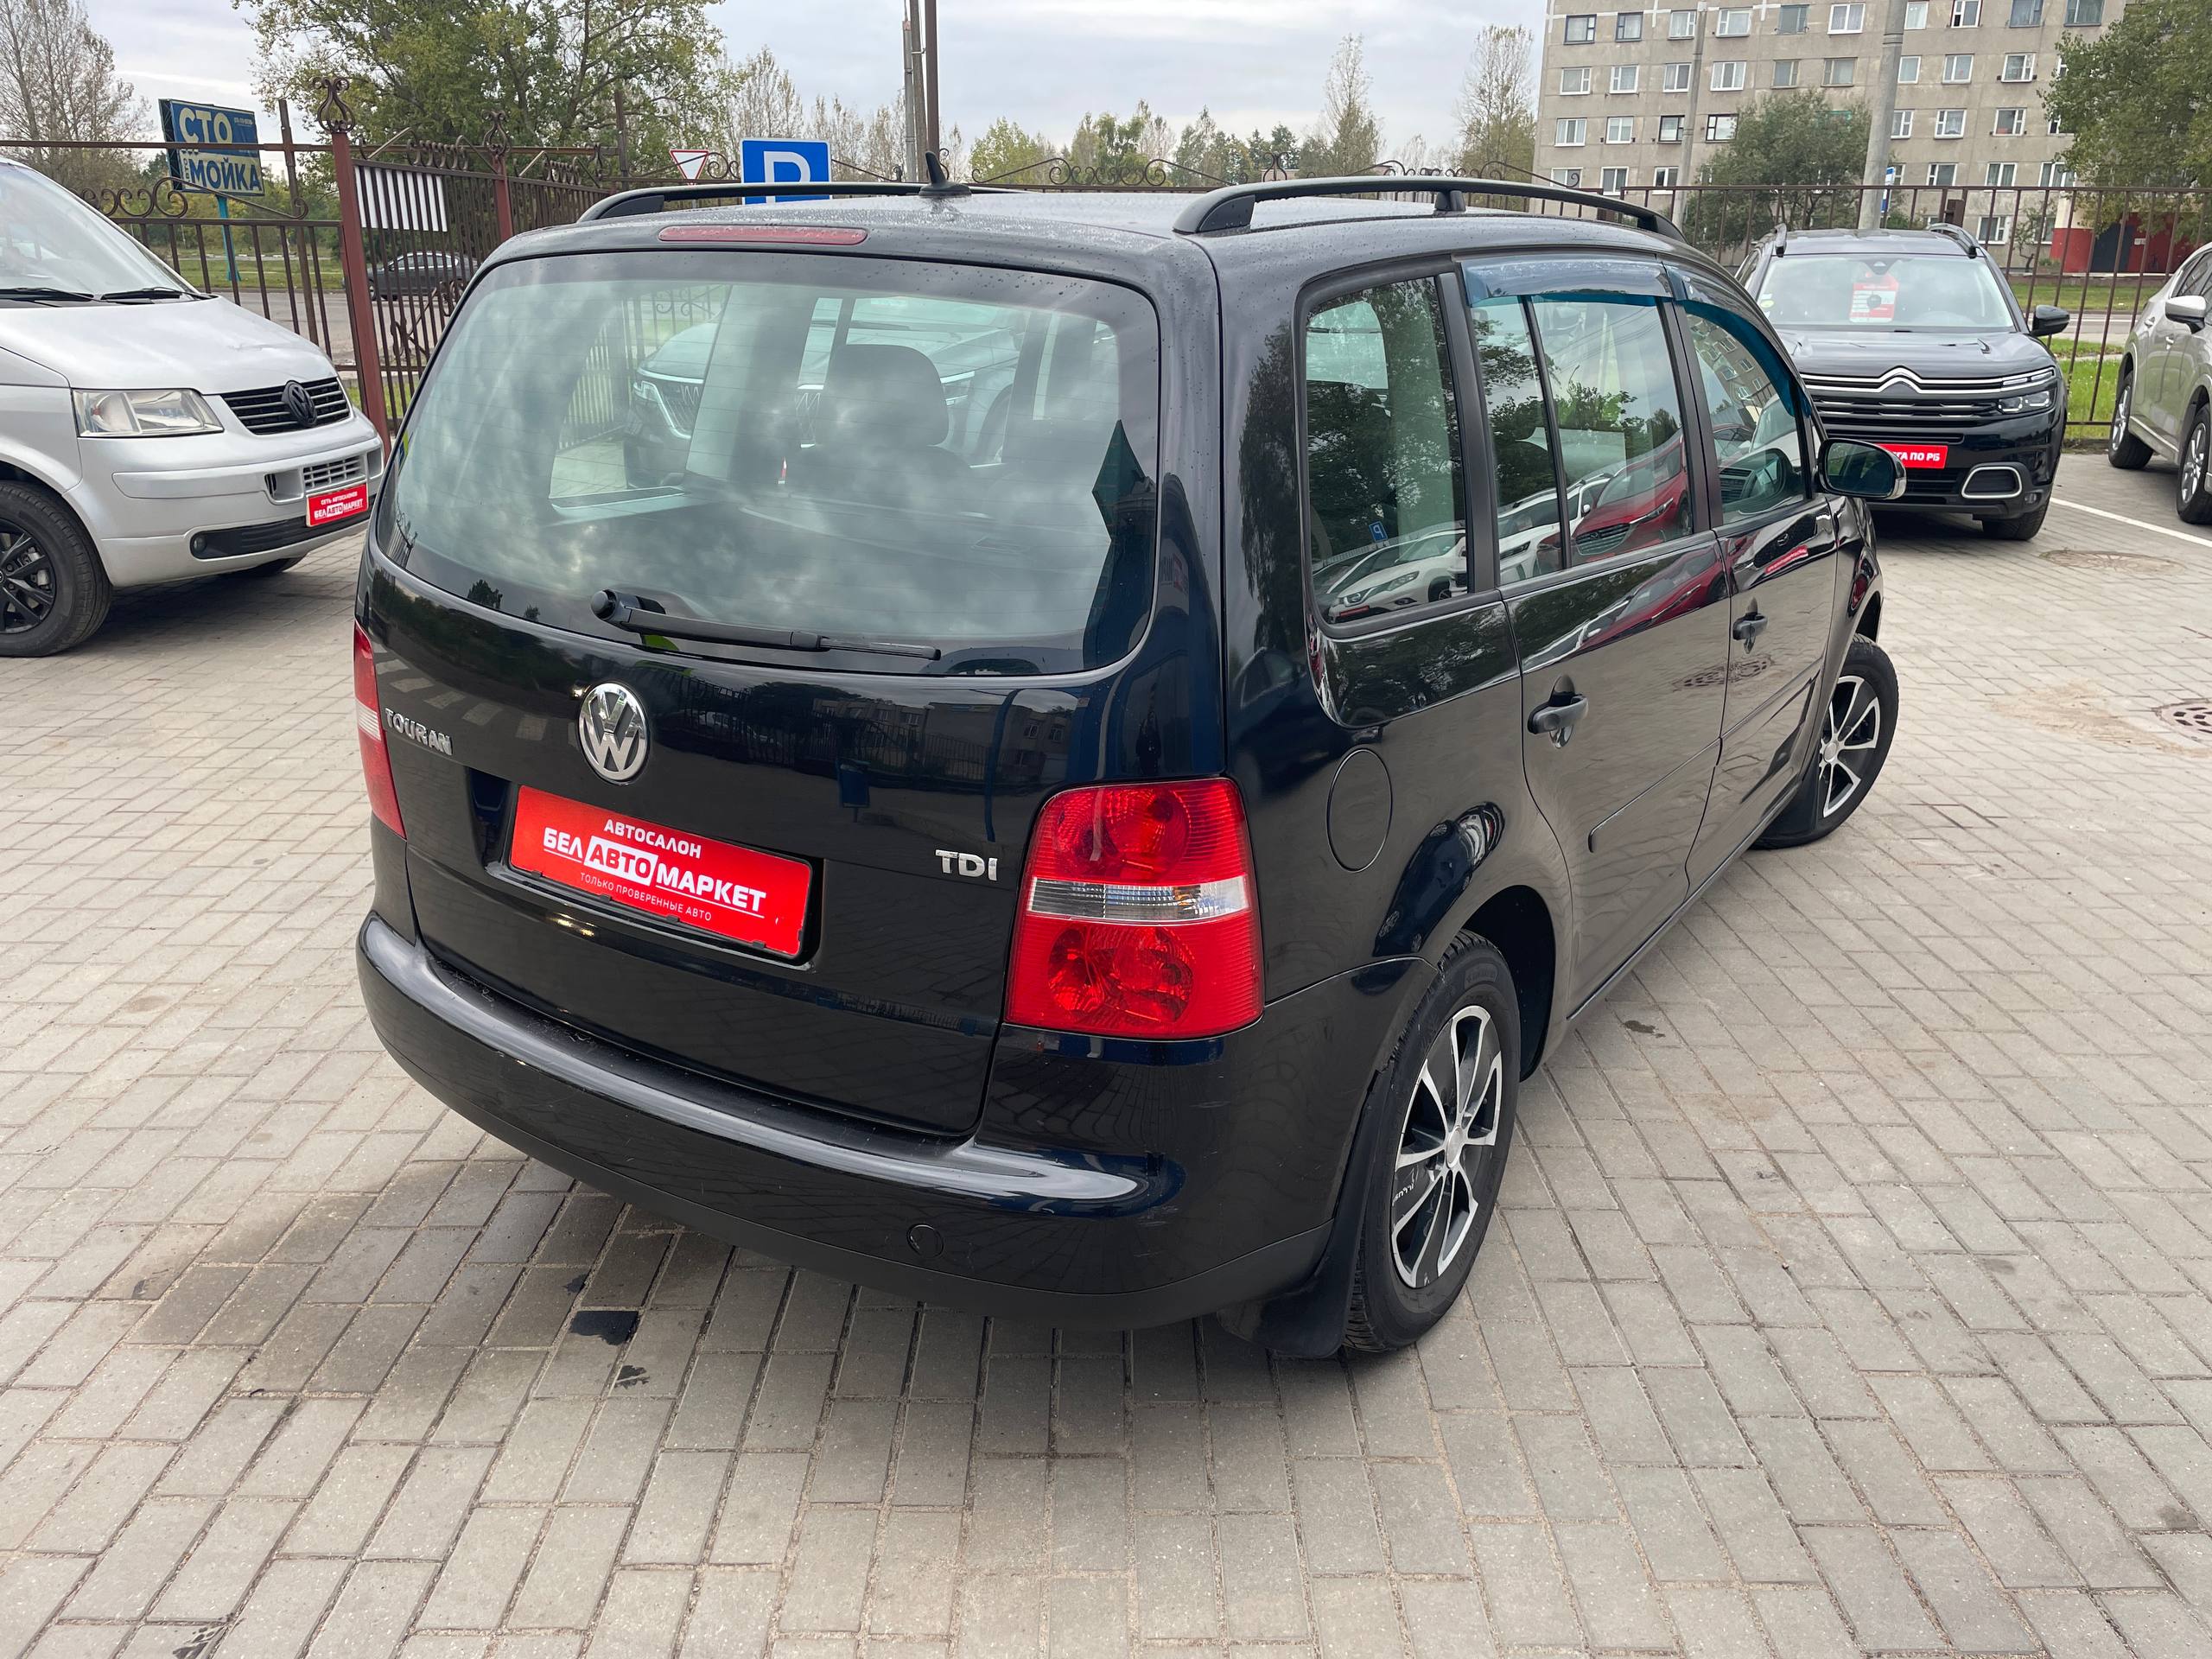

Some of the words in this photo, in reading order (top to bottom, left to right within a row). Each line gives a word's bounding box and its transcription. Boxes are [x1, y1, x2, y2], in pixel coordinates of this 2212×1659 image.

[179, 107, 232, 143] СТО
[188, 157, 262, 191] МОЙКА
[764, 150, 810, 204] P
[1910, 452, 1924, 461] ПО
[1926, 452, 1941, 461] РБ
[385, 708, 452, 756] TOURAN
[604, 819, 702, 859] АВТОСАЛОН
[935, 849, 998, 881] TDI
[581, 871, 614, 891] ТОЛЬКО
[616, 884, 683, 913] ПРОВЕРЕННЫЕ
[685, 903, 712, 921] АВТО
